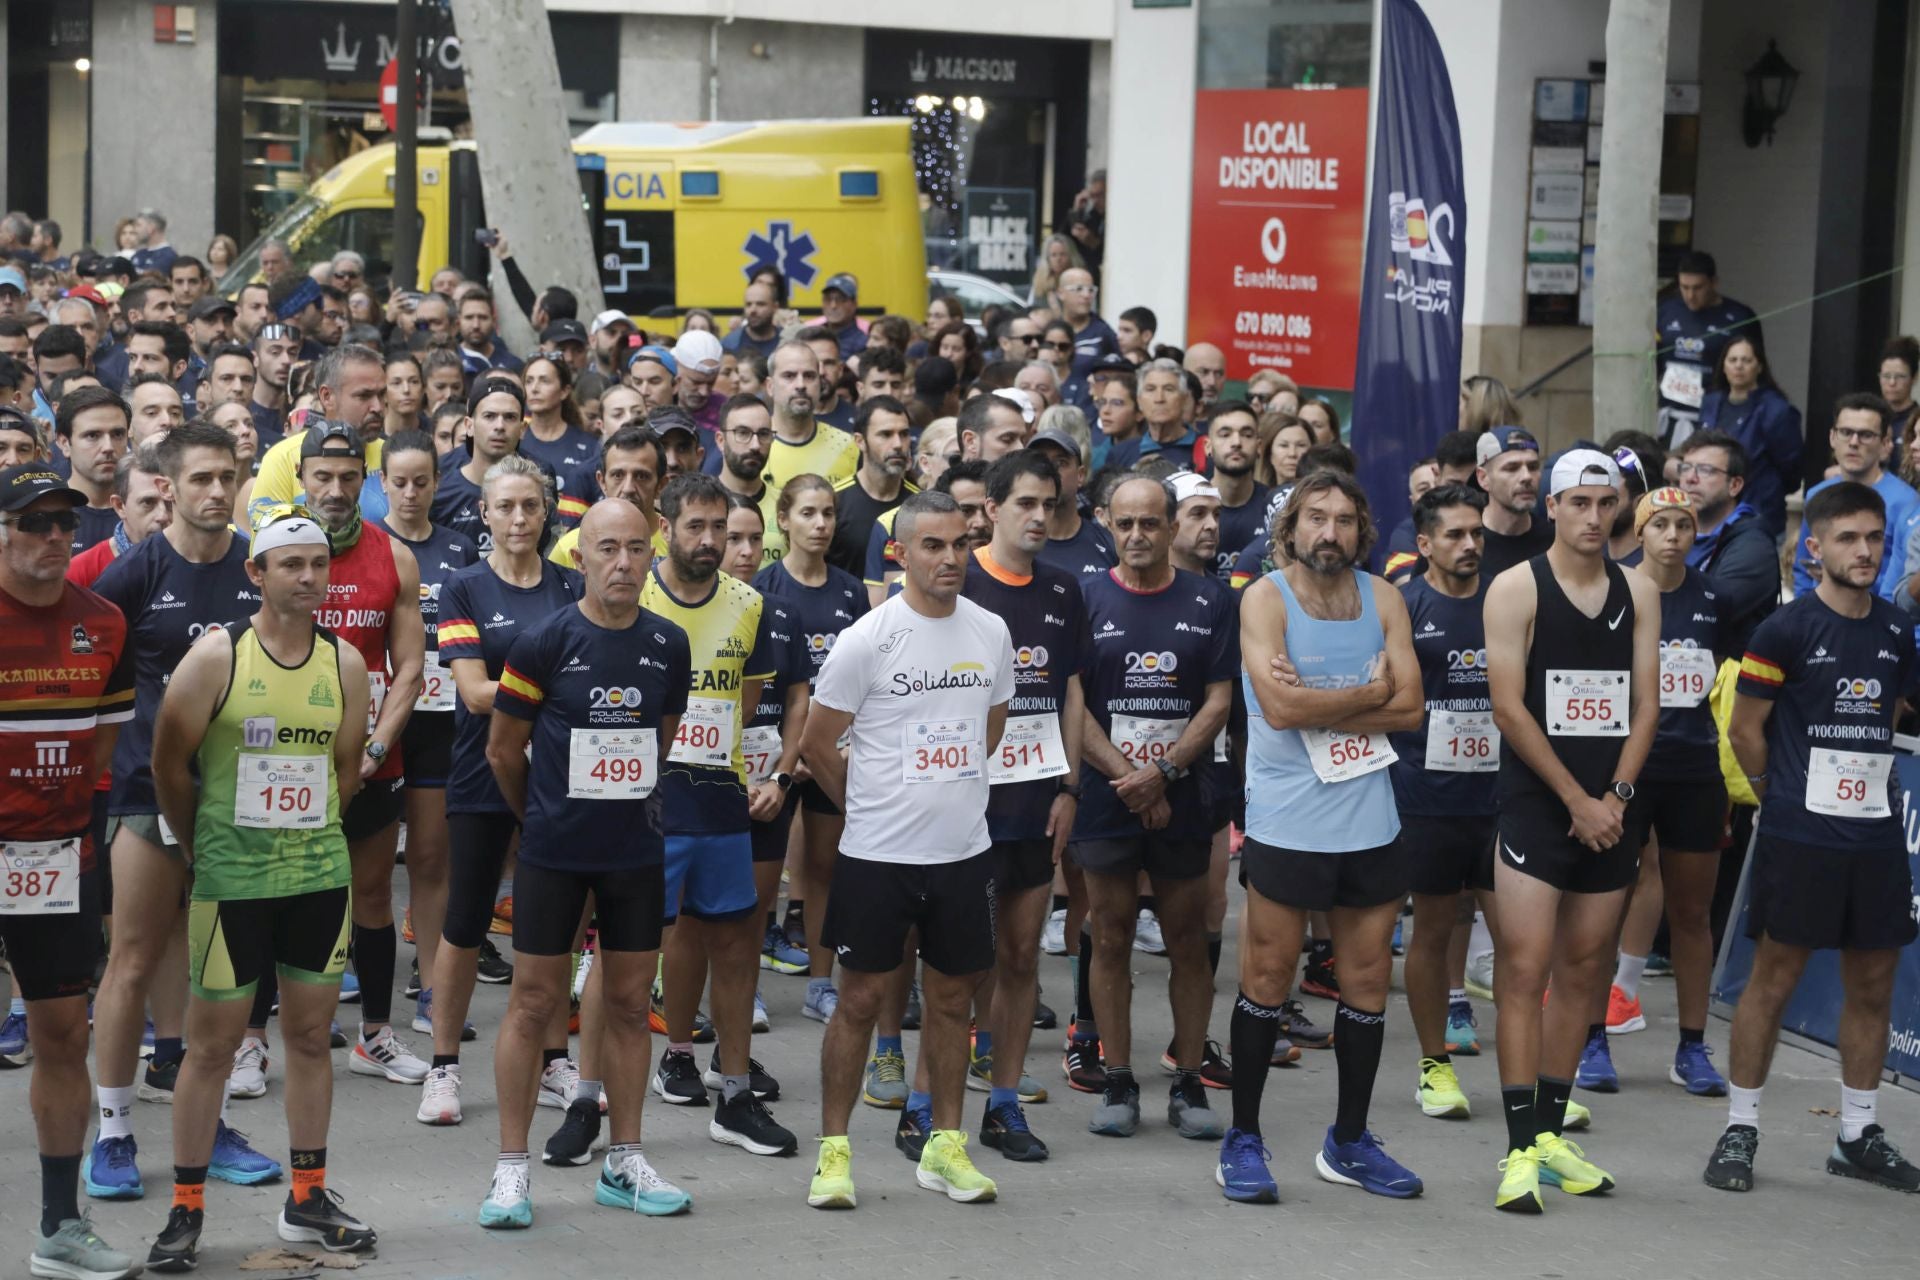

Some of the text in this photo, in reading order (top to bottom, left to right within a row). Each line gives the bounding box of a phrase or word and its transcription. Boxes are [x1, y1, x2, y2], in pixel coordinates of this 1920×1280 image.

[934, 57, 1017, 83] MACSON
[1243, 121, 1310, 154] LOCAL
[604, 173, 666, 200] CIA
[1219, 157, 1339, 191] DISPONIBLE
[969, 216, 1029, 244] BLACK
[1235, 311, 1312, 339] 670 890 086
[151, 601, 187, 611] Santander
[346, 610, 386, 629] DURO
[1093, 630, 1125, 640] Santander
[1415, 631, 1446, 640] Santander
[1125, 652, 1178, 673] 200
[0, 668, 101, 683] KAMIKAZES
[1662, 673, 1704, 694] 319
[589, 686, 642, 709] 200
[1836, 678, 1882, 700] 200
[1566, 699, 1612, 721] 555
[674, 724, 720, 750] 480
[1448, 737, 1490, 758] 136
[915, 745, 969, 771] 3401
[1003, 742, 1044, 768] 511
[1329, 734, 1375, 767] 562
[590, 758, 643, 783] 499
[260, 786, 312, 812] 150
[1836, 779, 1867, 802] 59
[5, 870, 61, 898] 387
